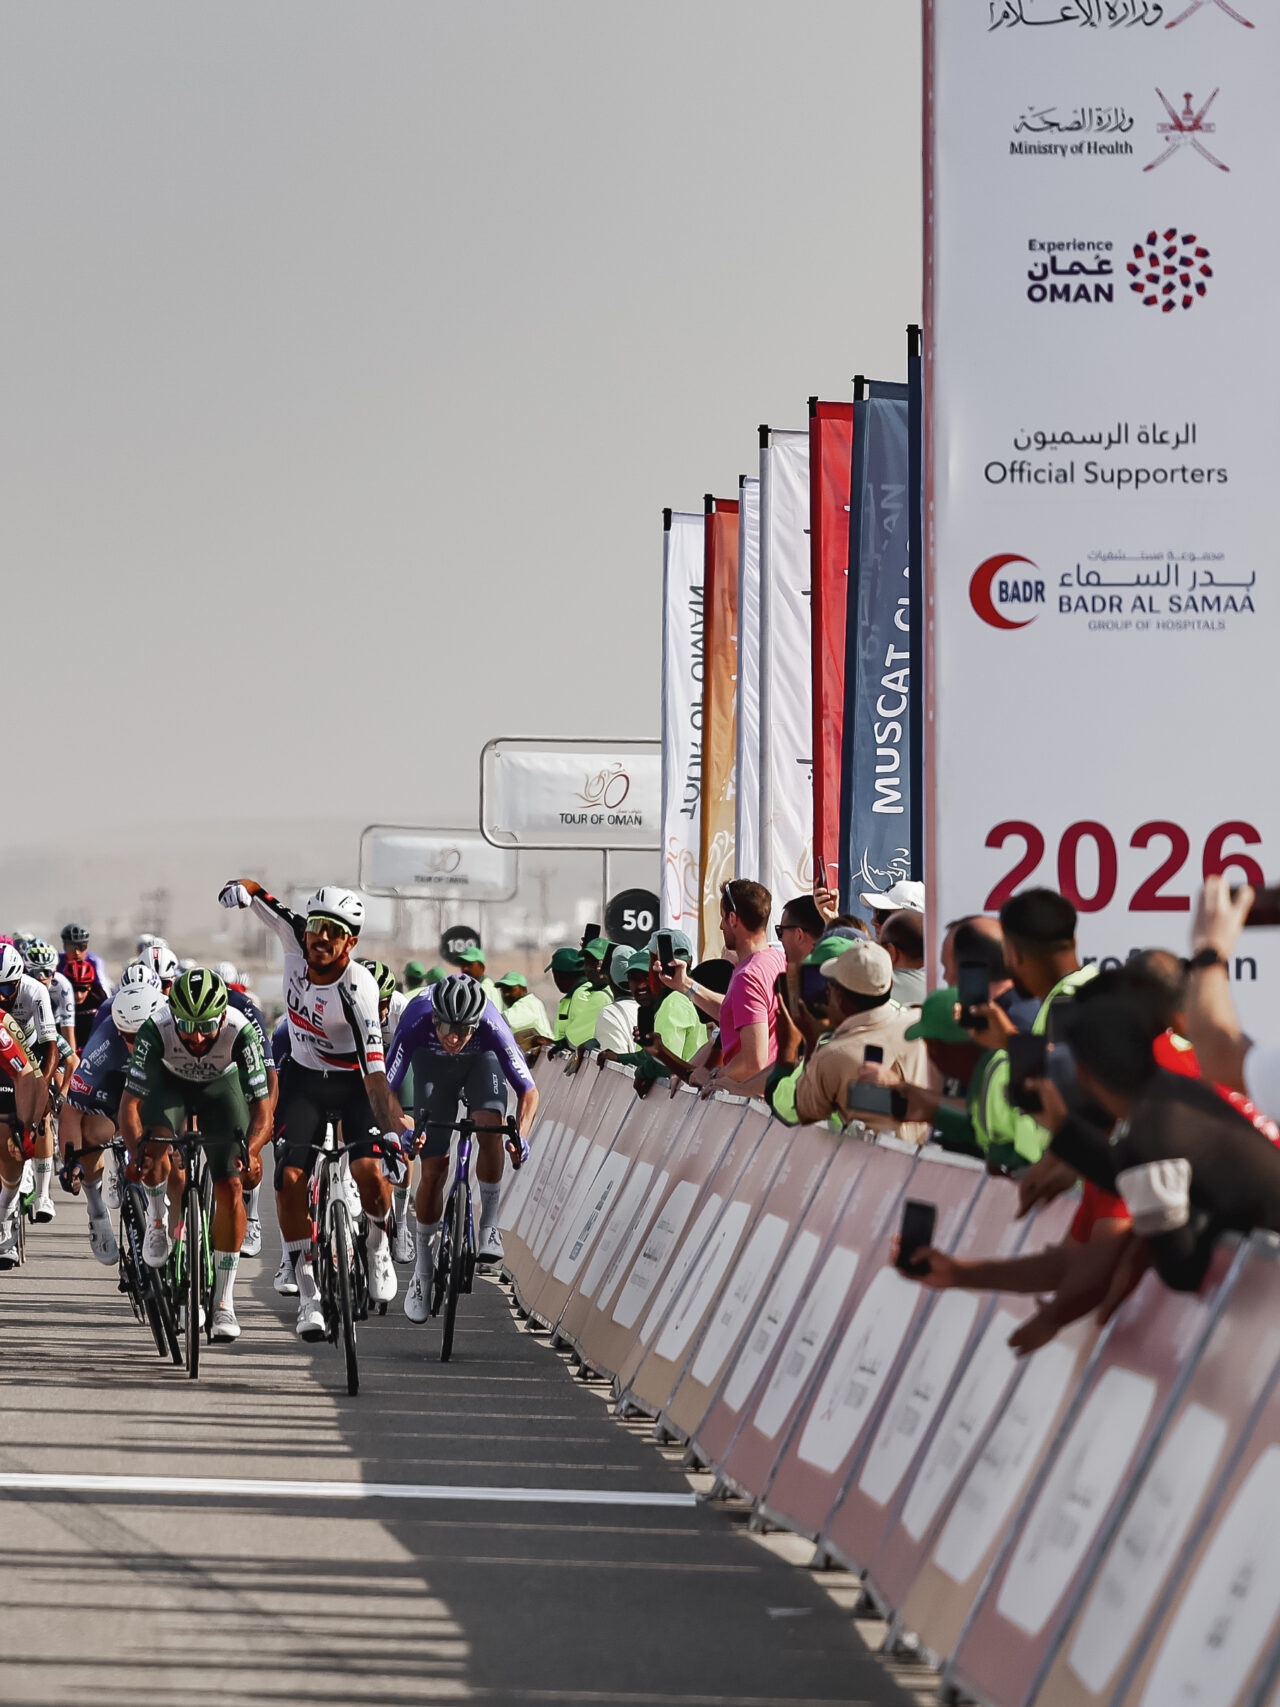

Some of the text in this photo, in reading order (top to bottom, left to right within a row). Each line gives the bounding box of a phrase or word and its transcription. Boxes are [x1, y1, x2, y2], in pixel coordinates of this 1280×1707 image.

[1095, 106, 1134, 133] وزارة
[1010, 140, 1133, 157] Ministry of Health
[1028, 239, 1113, 254] Experience
[1027, 283, 1113, 303] OMAN
[1013, 422, 1196, 451] الرعاة الرسميون
[984, 461, 1228, 489] Official Supporters
[1058, 563, 1256, 592] بدر السماء
[998, 580, 1045, 603] BADR
[1058, 595, 1256, 613] BADR AL SAMAA
[1088, 620, 1226, 631] GROUP OF HOSPITALS
[872, 643, 910, 814] MUSCAT
[559, 812, 642, 826] TOUR OF OMAN
[984, 820, 1265, 914] 2026
[622, 910, 653, 932] 50
[287, 988, 324, 1031] UAE
[88, 1040, 111, 1061] PREMIER
[387, 1042, 405, 1084] GIANT
[505, 1047, 530, 1080] GIANT
